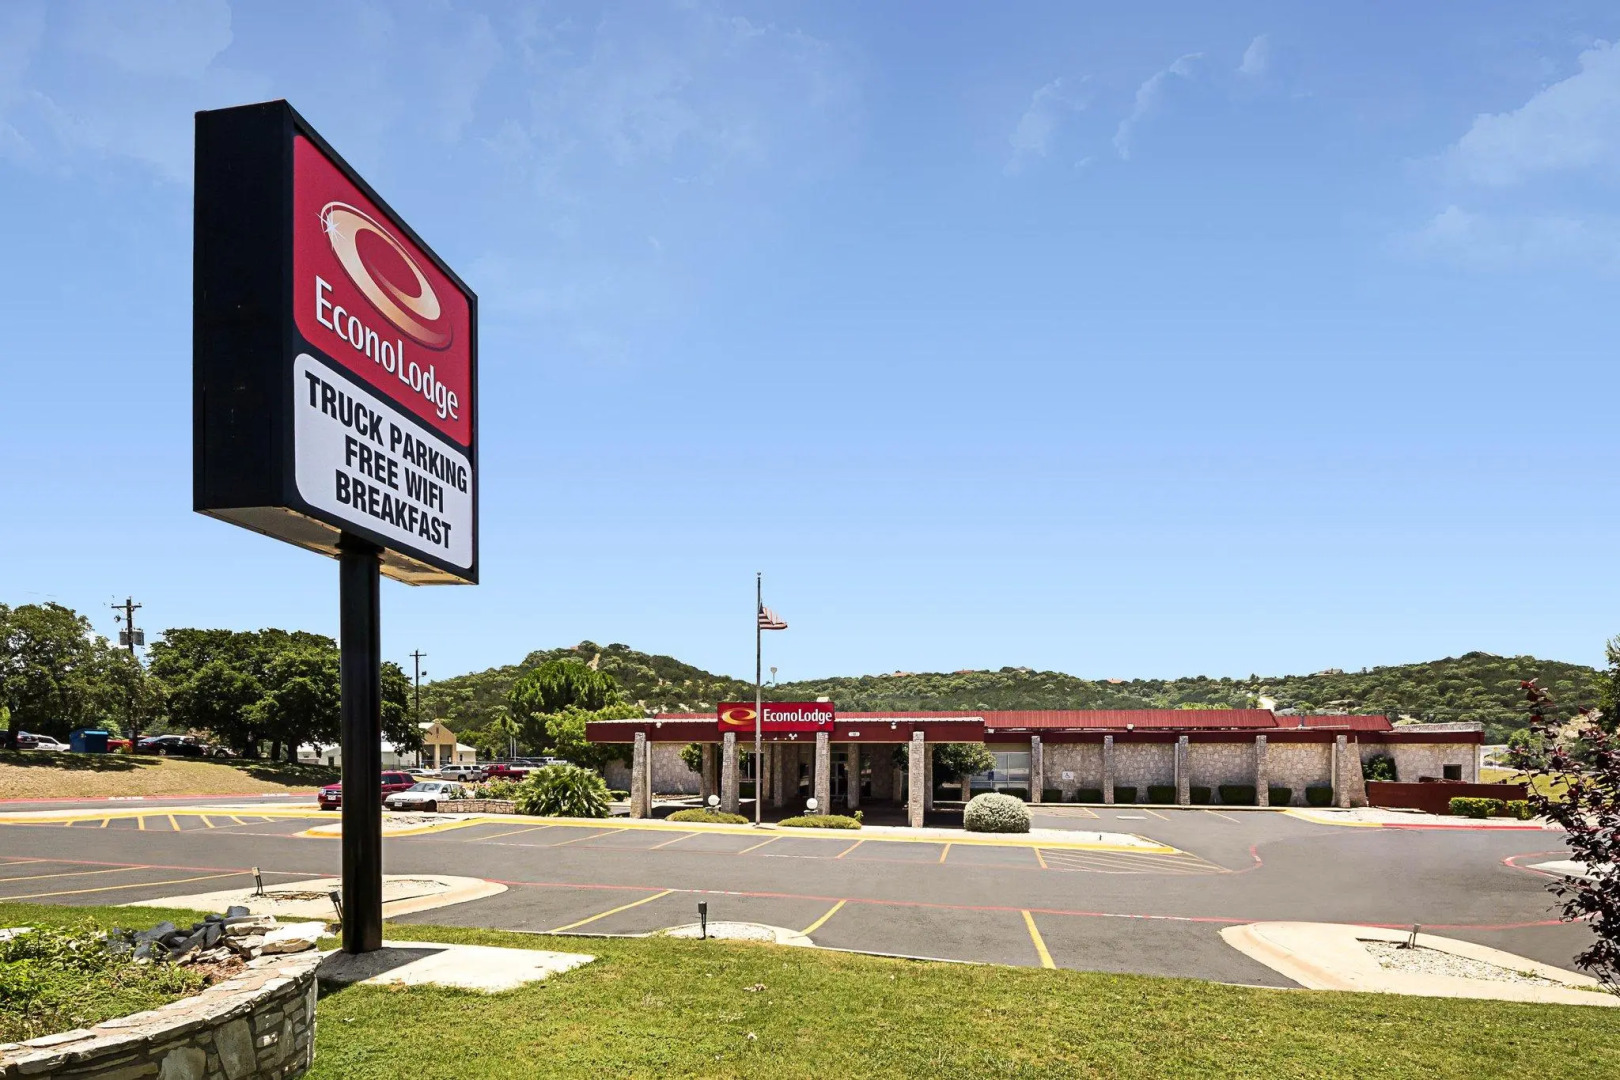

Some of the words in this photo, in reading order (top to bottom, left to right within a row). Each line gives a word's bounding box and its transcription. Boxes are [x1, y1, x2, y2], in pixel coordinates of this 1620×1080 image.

[315, 274, 459, 420] EconoLodge
[304, 369, 385, 447] TRUCK
[389, 421, 468, 495] PARKING
[335, 468, 452, 549] BREAKFAST
[345, 433, 399, 491] FREE
[404, 466, 444, 514] WIFI
[763, 708, 832, 724] EconoLodge
